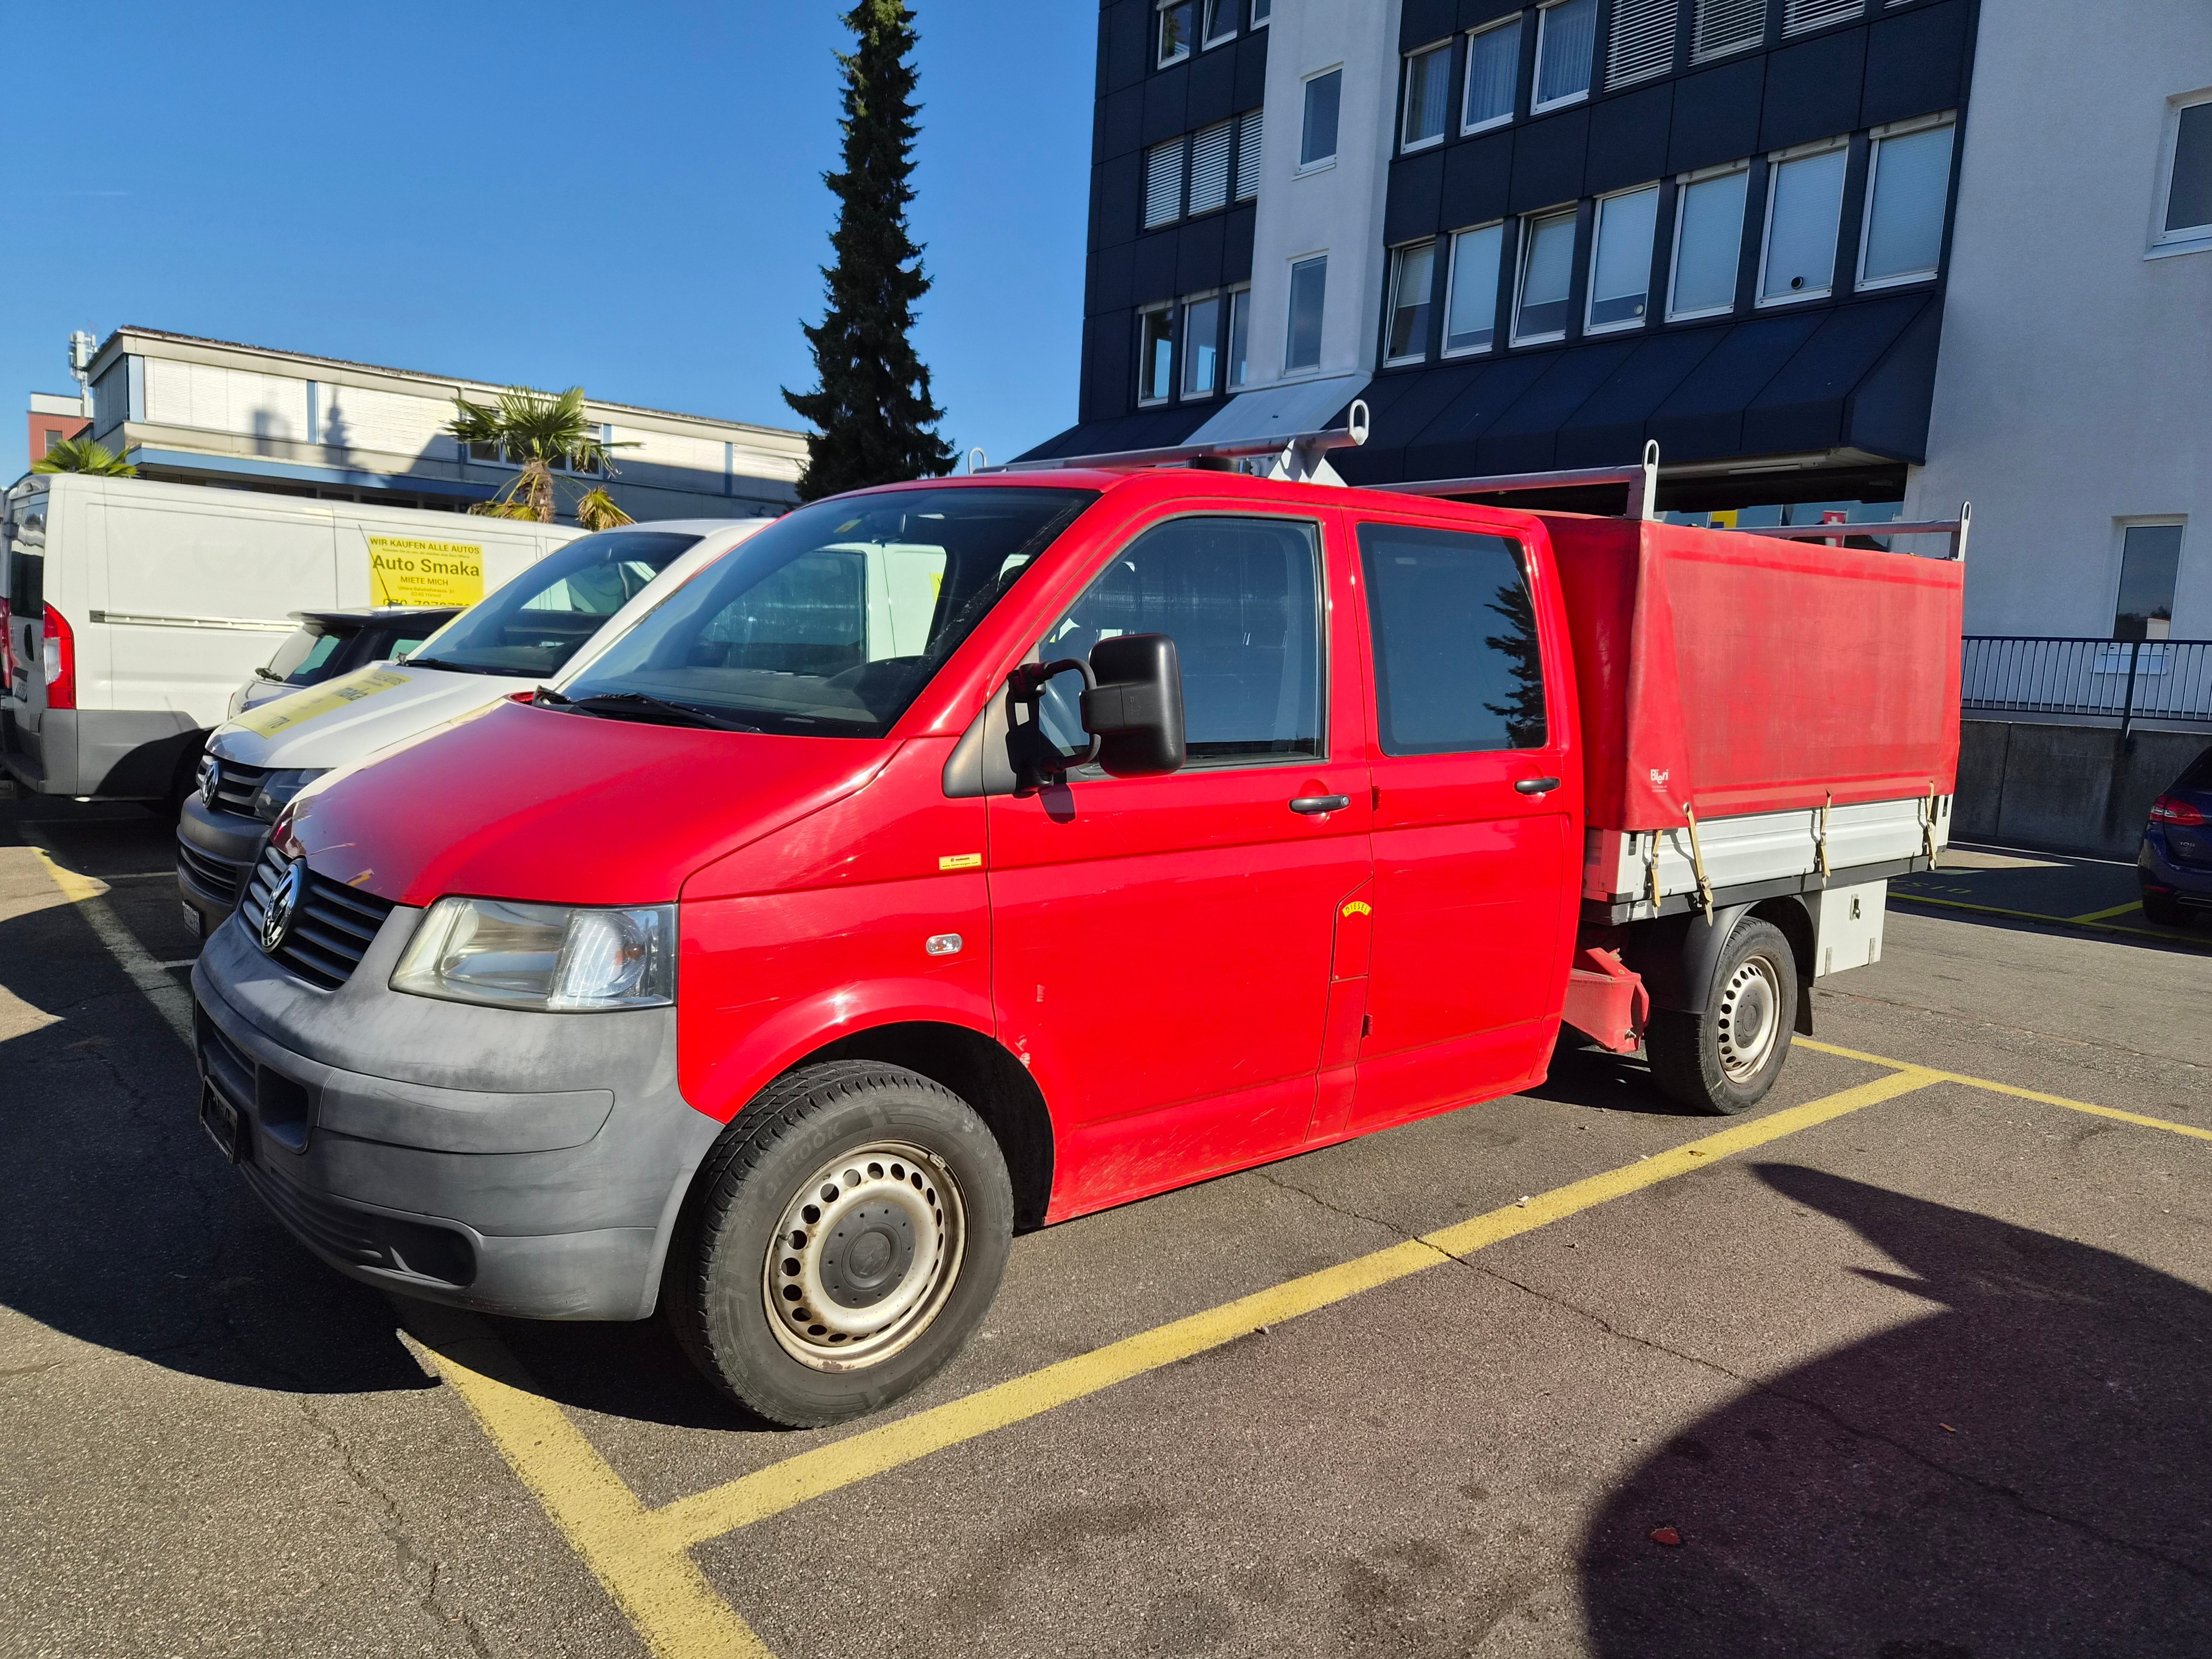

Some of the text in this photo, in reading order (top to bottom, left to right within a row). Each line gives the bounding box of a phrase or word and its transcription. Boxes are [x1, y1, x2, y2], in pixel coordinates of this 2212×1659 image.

[370, 538, 479, 554] WIR KAUFEN ALLE AUTOS
[373, 555, 479, 577] Auto Smaka
[400, 576, 425, 585] MIETE
[1650, 769, 1669, 784] Bieri
[1888, 879, 1972, 894] YSIO
[1345, 902, 1368, 914] DIESEL
